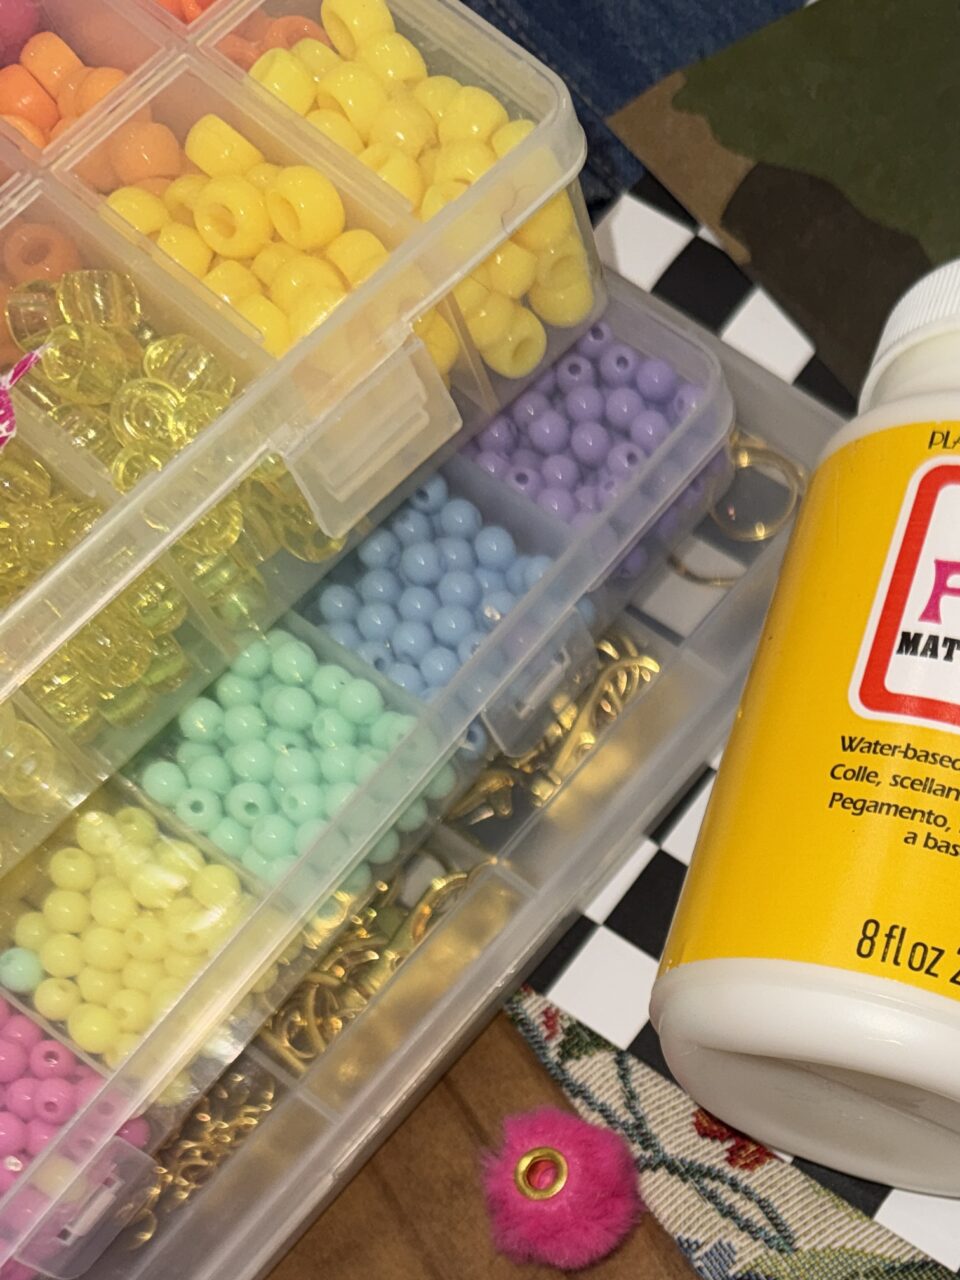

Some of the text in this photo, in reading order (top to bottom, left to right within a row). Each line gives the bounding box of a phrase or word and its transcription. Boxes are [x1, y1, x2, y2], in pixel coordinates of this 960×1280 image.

[830, 763, 882, 788] Colle,
[827, 791, 951, 833] Pegamento,
[903, 830, 918, 846] a
